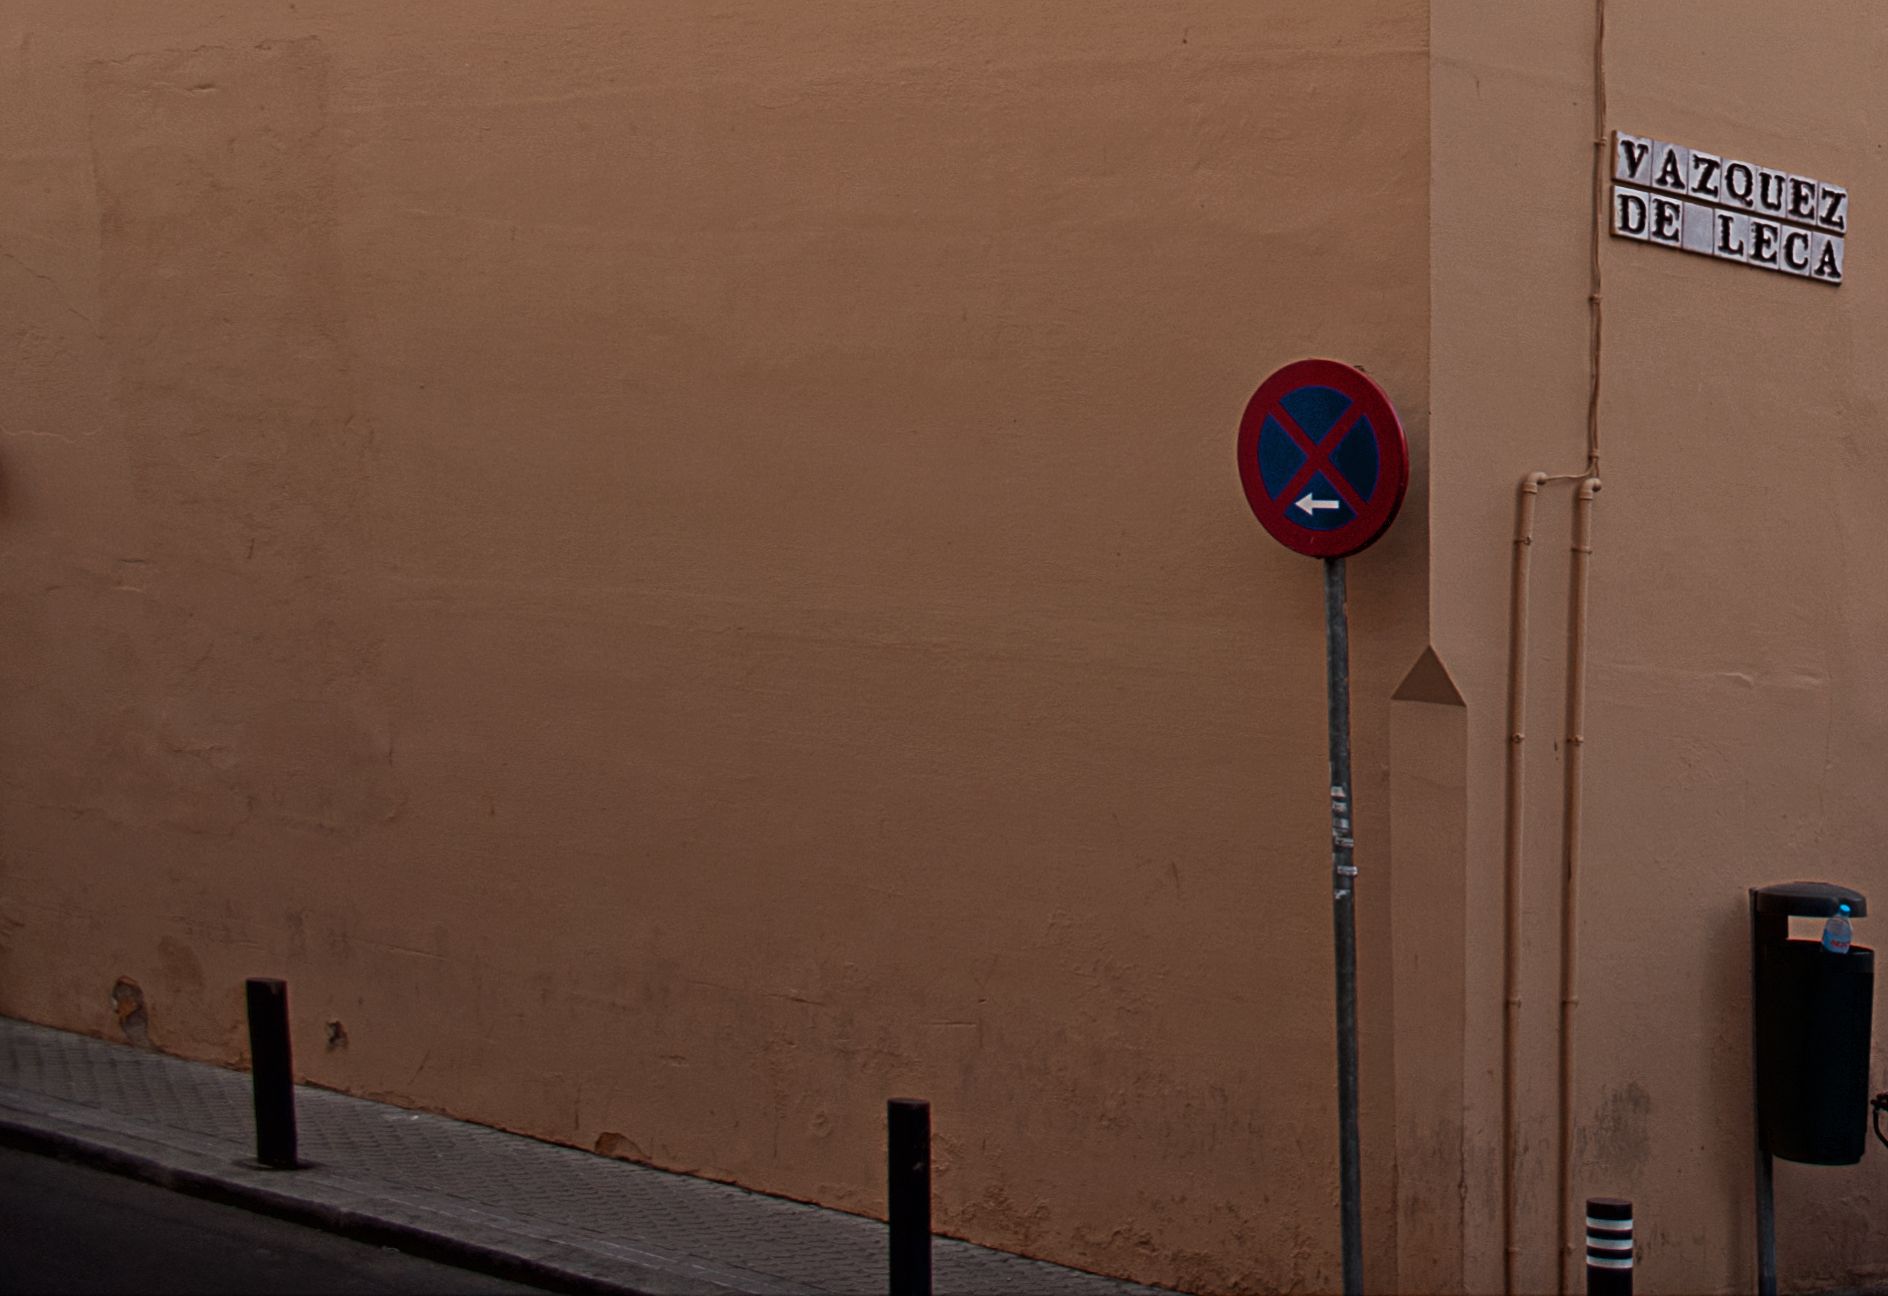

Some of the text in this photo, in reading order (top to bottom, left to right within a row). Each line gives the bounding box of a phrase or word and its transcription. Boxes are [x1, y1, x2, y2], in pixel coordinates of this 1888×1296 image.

[1619, 139, 1847, 231] VAZQUEZ
[1617, 193, 1842, 279] DE LECA
